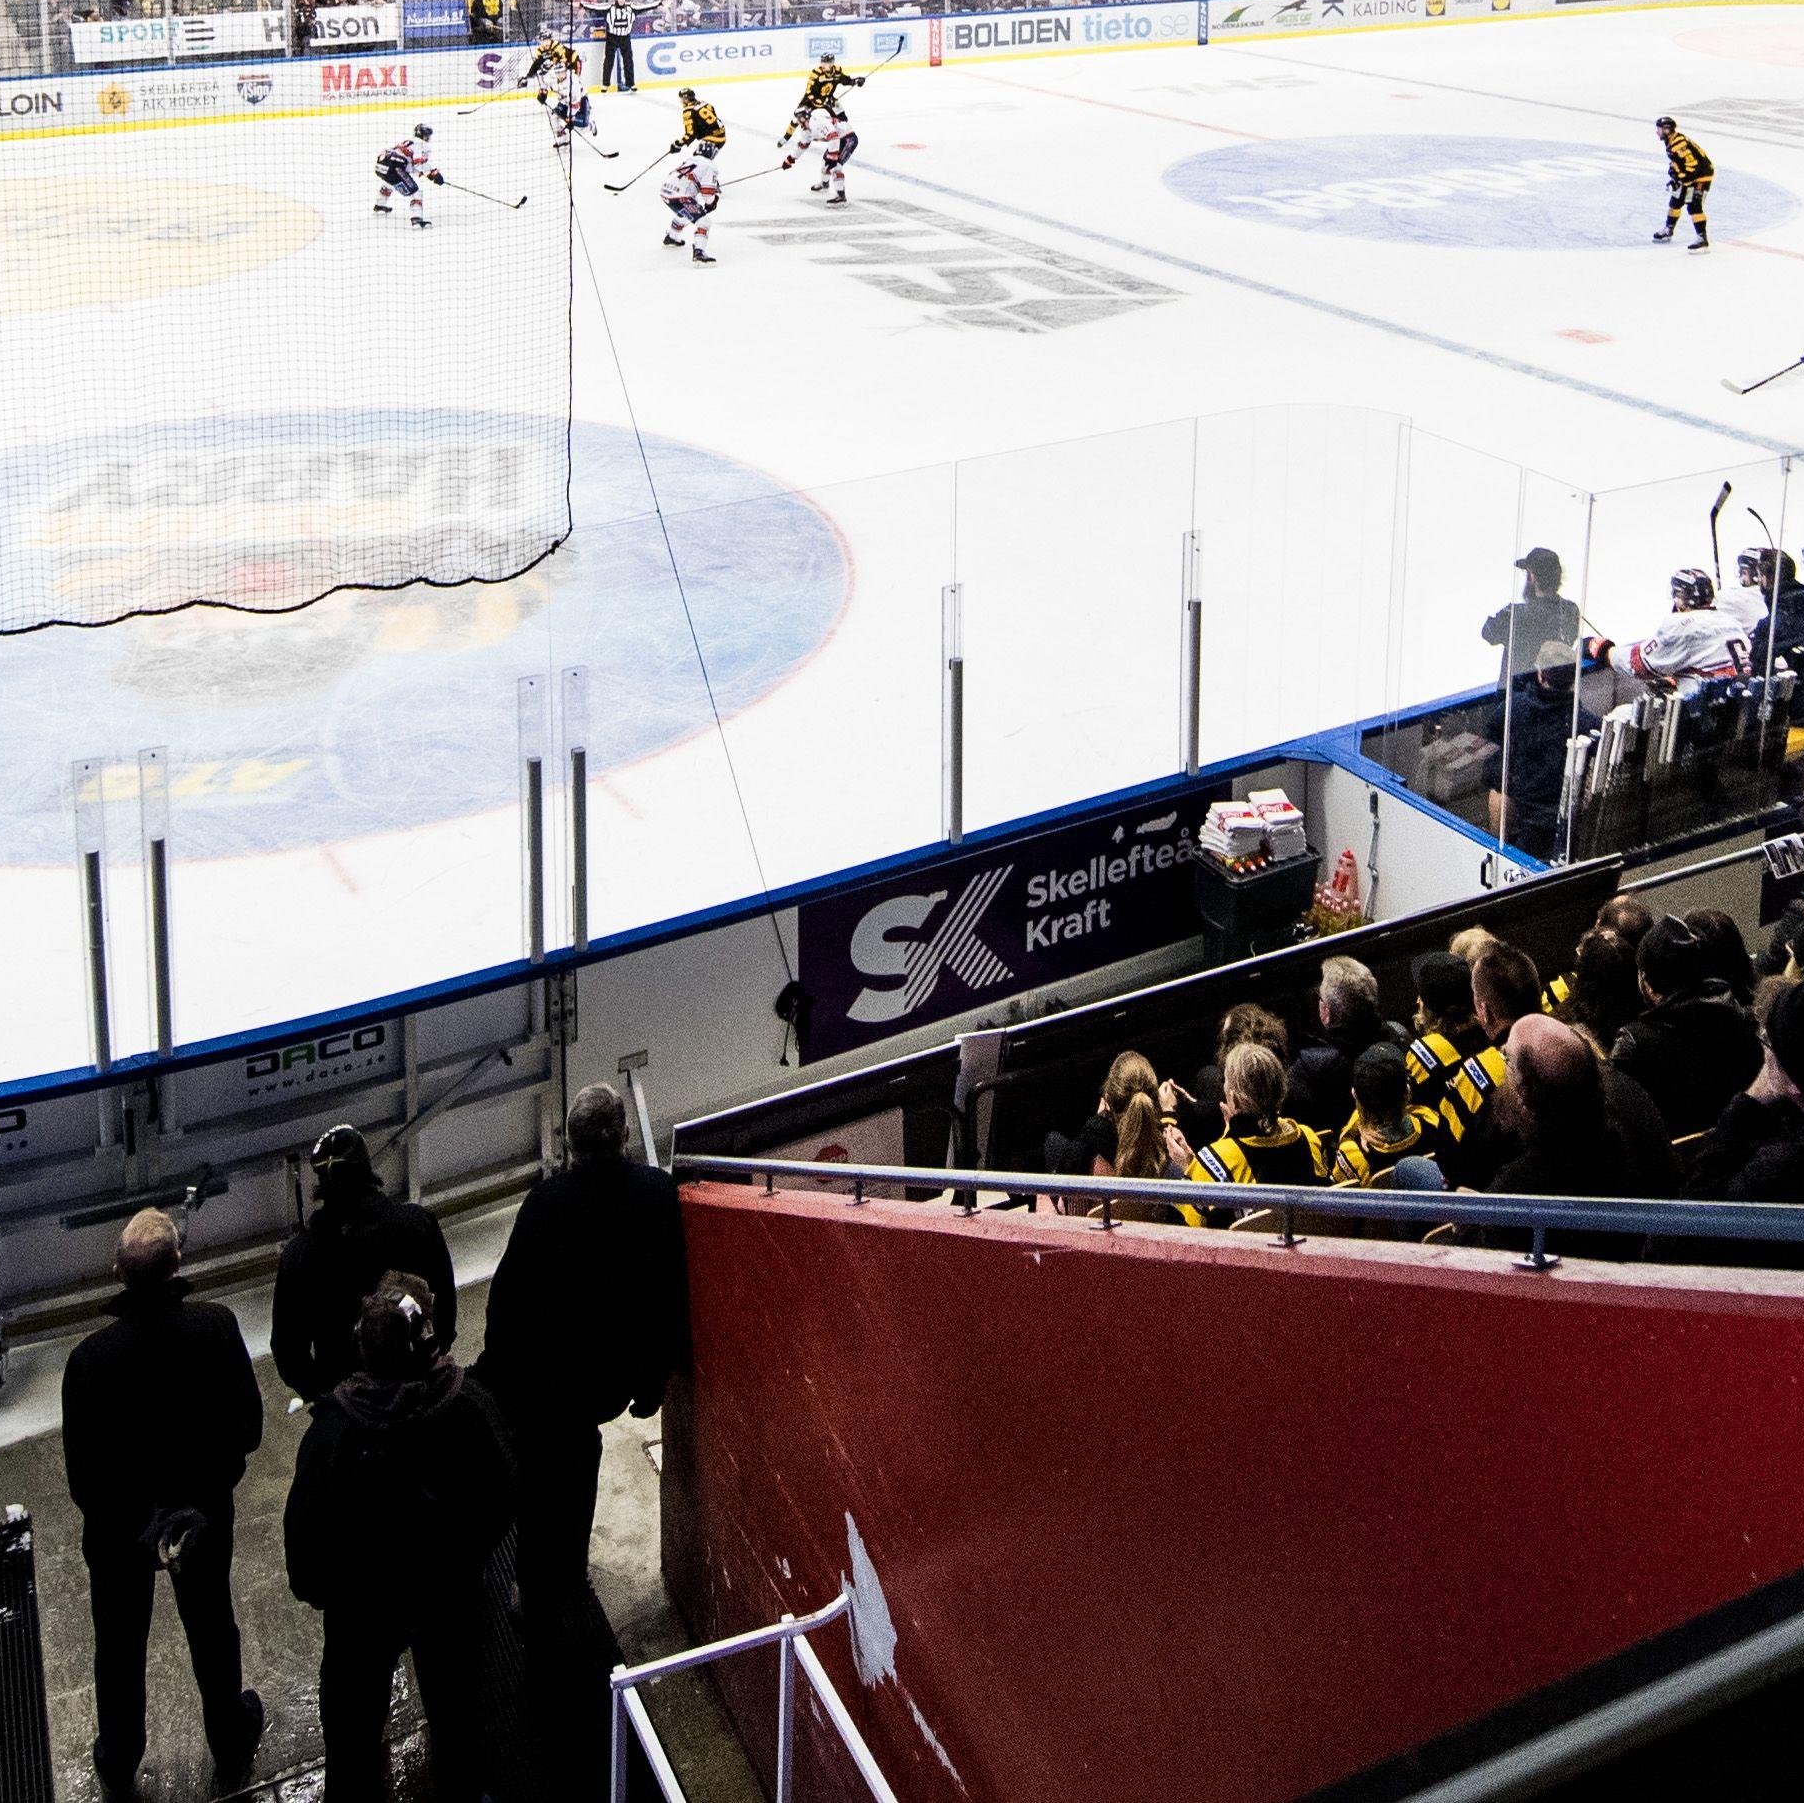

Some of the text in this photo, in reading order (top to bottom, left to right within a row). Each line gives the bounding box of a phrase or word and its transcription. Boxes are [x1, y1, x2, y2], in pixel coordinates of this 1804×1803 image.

[1354, 0, 1416, 17] KAIDING
[100, 21, 181, 44] SPORT
[954, 17, 1071, 49] BOLIDEN
[1083, 13, 1189, 42] tieto.se
[679, 42, 773, 63] extena
[322, 64, 408, 92] MAXI
[170, 94, 218, 108] HOCKEY
[1026, 827, 1195, 909] Skellefteå
[1026, 898, 1111, 953] Kraft
[246, 1024, 385, 1081] DACO
[248, 1053, 386, 1098] www.daco.se
